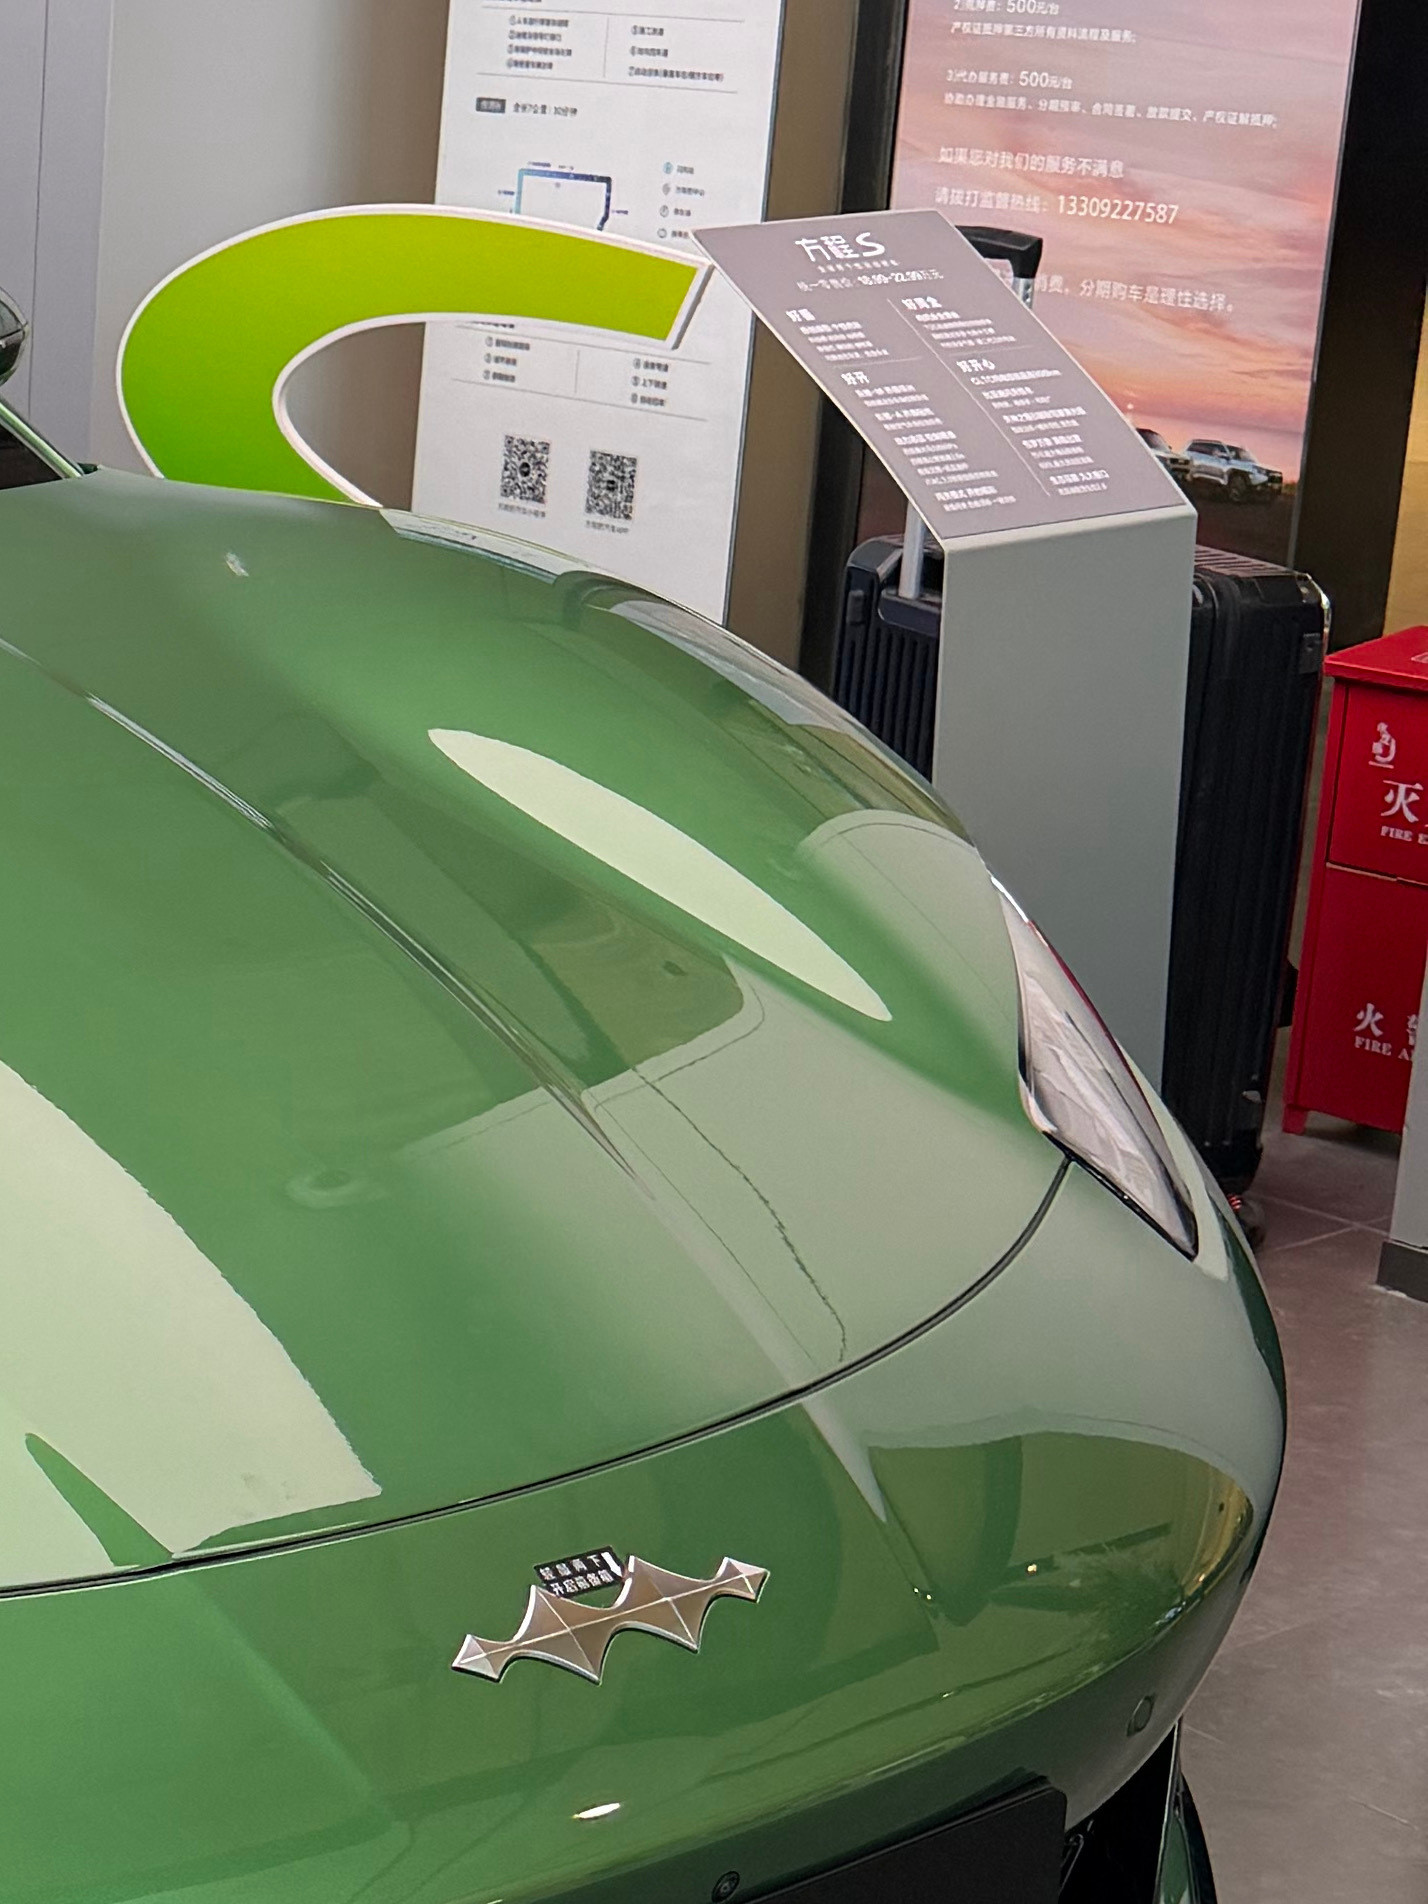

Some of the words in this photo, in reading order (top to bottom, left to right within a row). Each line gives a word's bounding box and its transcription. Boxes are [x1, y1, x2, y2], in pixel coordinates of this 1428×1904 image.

[937, 147, 1125, 179] 如果您对我们的服务不满意
[1380, 780, 1428, 827] 灭
[1380, 825, 1413, 842] FIRE
[1354, 1035, 1392, 1056] FIRE
